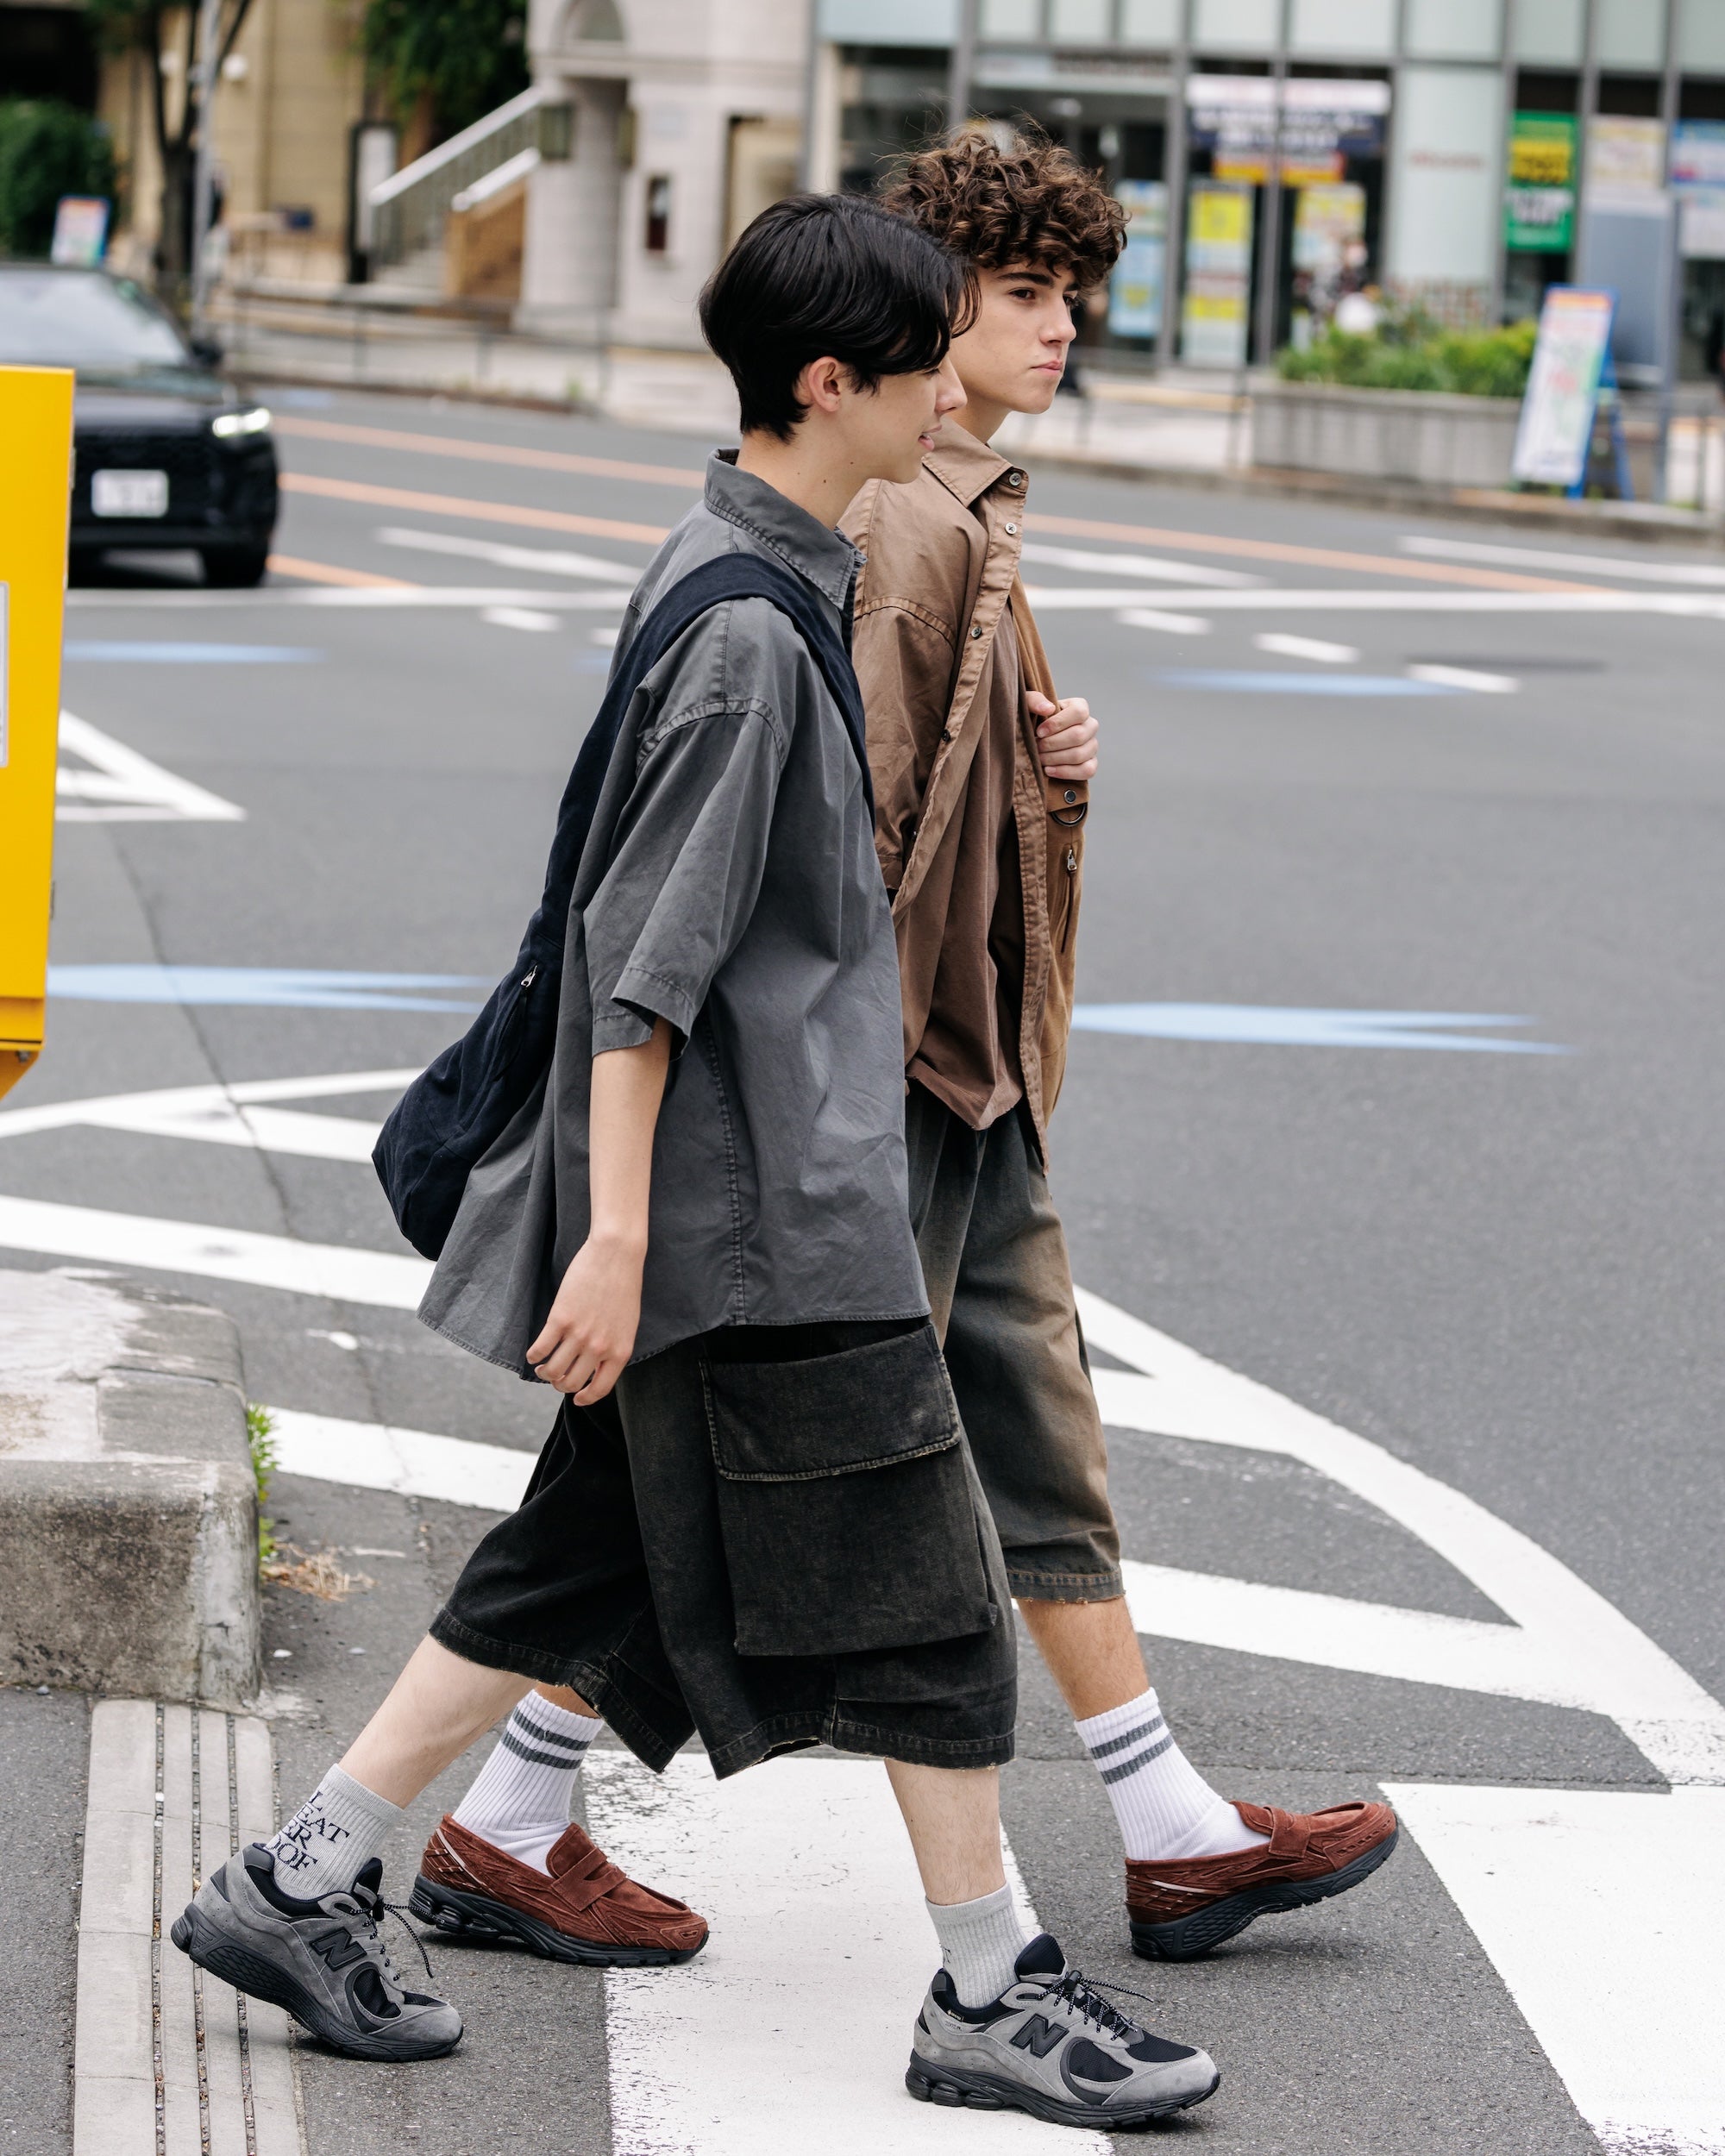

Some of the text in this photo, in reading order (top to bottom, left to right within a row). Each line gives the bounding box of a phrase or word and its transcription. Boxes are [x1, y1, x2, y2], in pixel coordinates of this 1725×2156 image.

[296, 1804, 350, 1843] EAT
[310, 1927, 367, 1972] N
[1009, 2013, 1070, 2059] N
